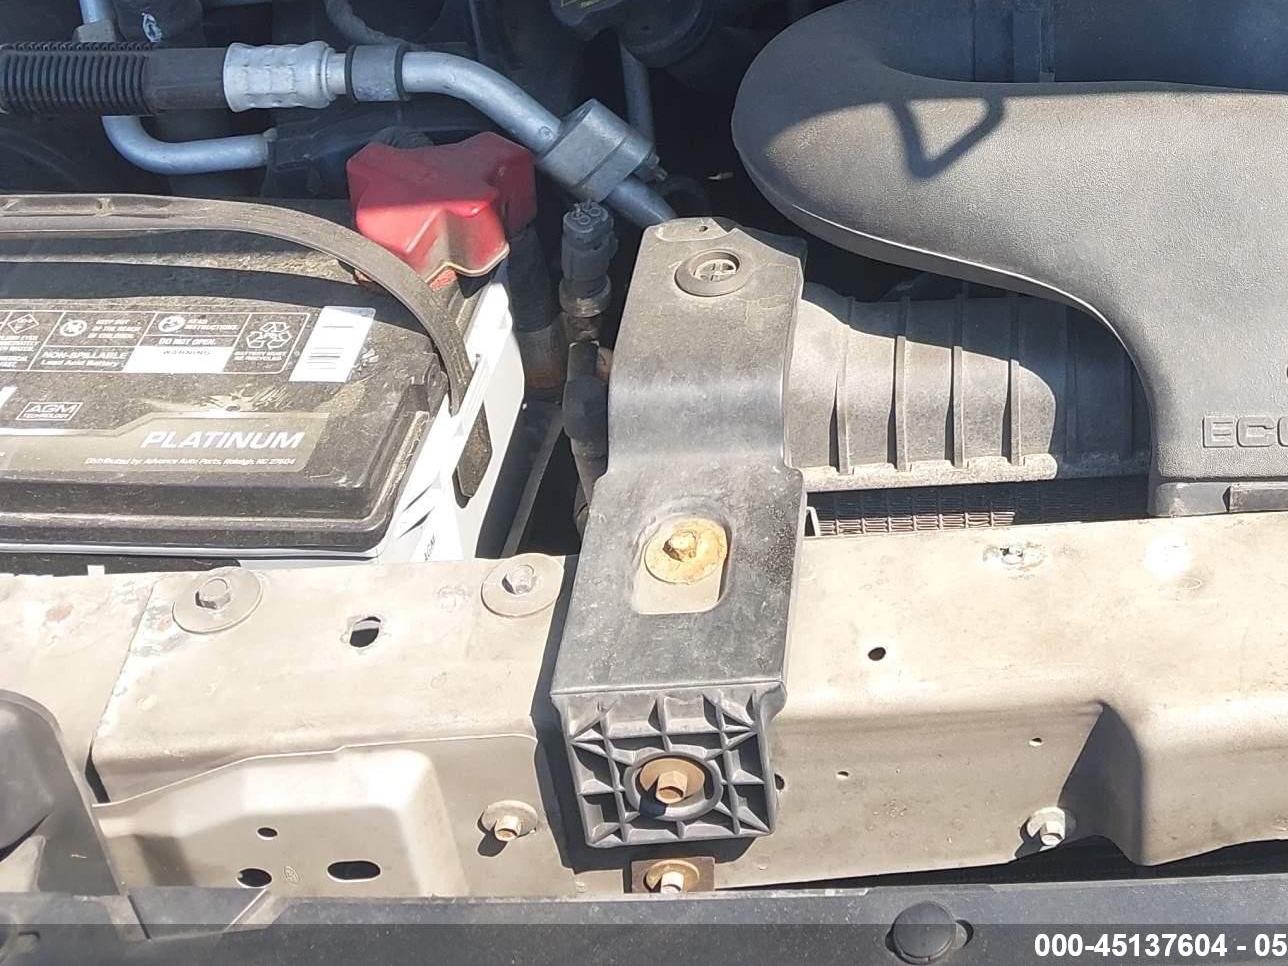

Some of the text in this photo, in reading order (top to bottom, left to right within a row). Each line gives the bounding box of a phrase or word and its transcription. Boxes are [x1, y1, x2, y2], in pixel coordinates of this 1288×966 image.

[26, 404, 78, 413] AGM
[140, 431, 305, 449] PLATINUM
[85, 457, 131, 465] Distributed
